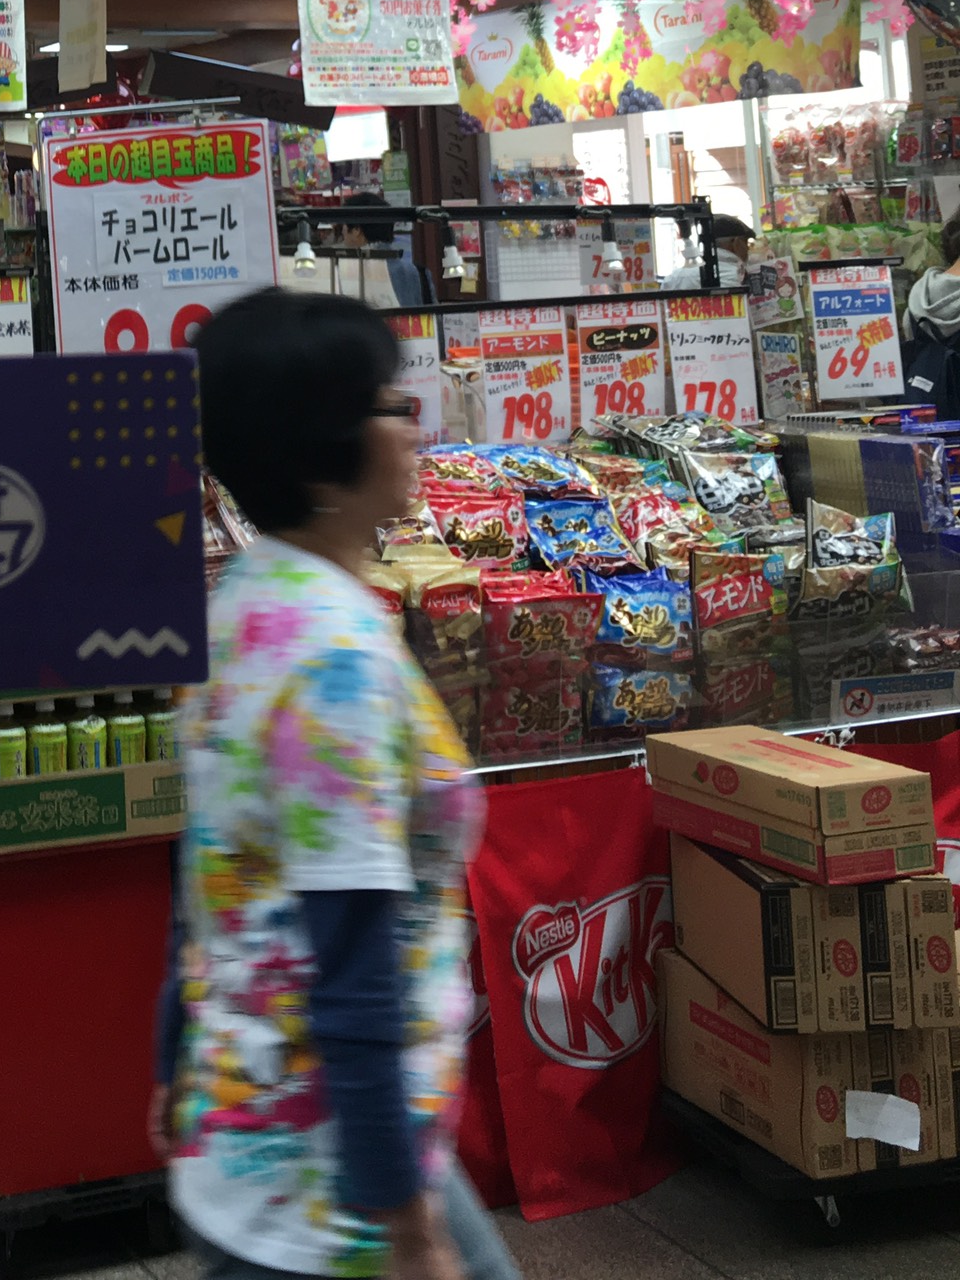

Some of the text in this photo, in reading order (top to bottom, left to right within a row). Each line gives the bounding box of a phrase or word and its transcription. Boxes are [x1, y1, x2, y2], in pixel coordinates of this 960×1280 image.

[66, 133, 252, 184] 本日の超目玉商品！
[101, 204, 238, 237] チョコリエール
[113, 235, 230, 265] バームロール
[64, 273, 140, 294] 本体価格
[166, 266, 239, 283] 定価150円を
[819, 293, 886, 310] アルフォート
[486, 335, 550, 352] アーモンド
[591, 328, 651, 346] ピーナッツ
[760, 335, 798, 353] ORIHIRO
[828, 342, 870, 380] 69
[683, 378, 737, 422] 178
[502, 391, 553, 440] 198
[699, 575, 764, 620] アーモンド
